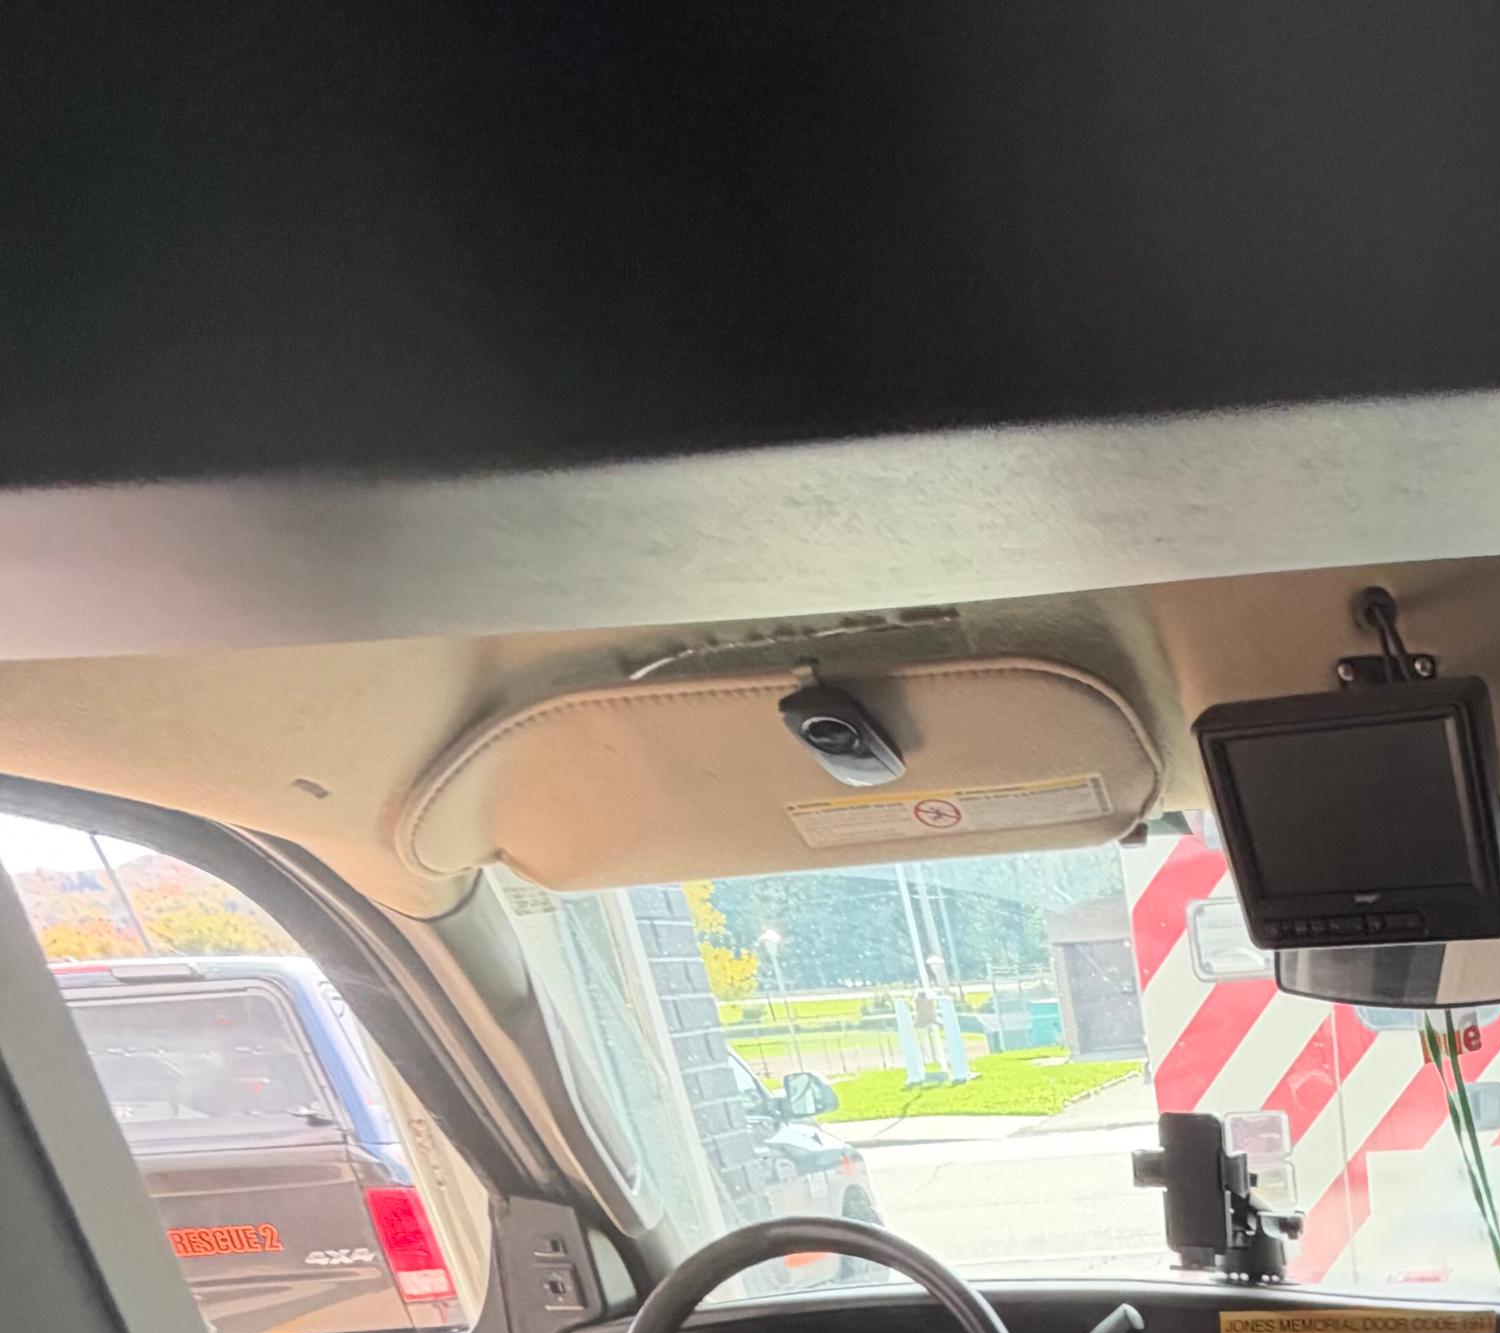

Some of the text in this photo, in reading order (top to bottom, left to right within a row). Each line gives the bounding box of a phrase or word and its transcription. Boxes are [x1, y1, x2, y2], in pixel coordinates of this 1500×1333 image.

[168, 1223, 284, 1256] RESCUE 2
[1225, 1319, 1275, 1333] JONES
[1279, 1318, 1360, 1333] MEMORIAL
[1362, 1317, 1408, 1332] DOOR
[1411, 1316, 1458, 1331] CODE
